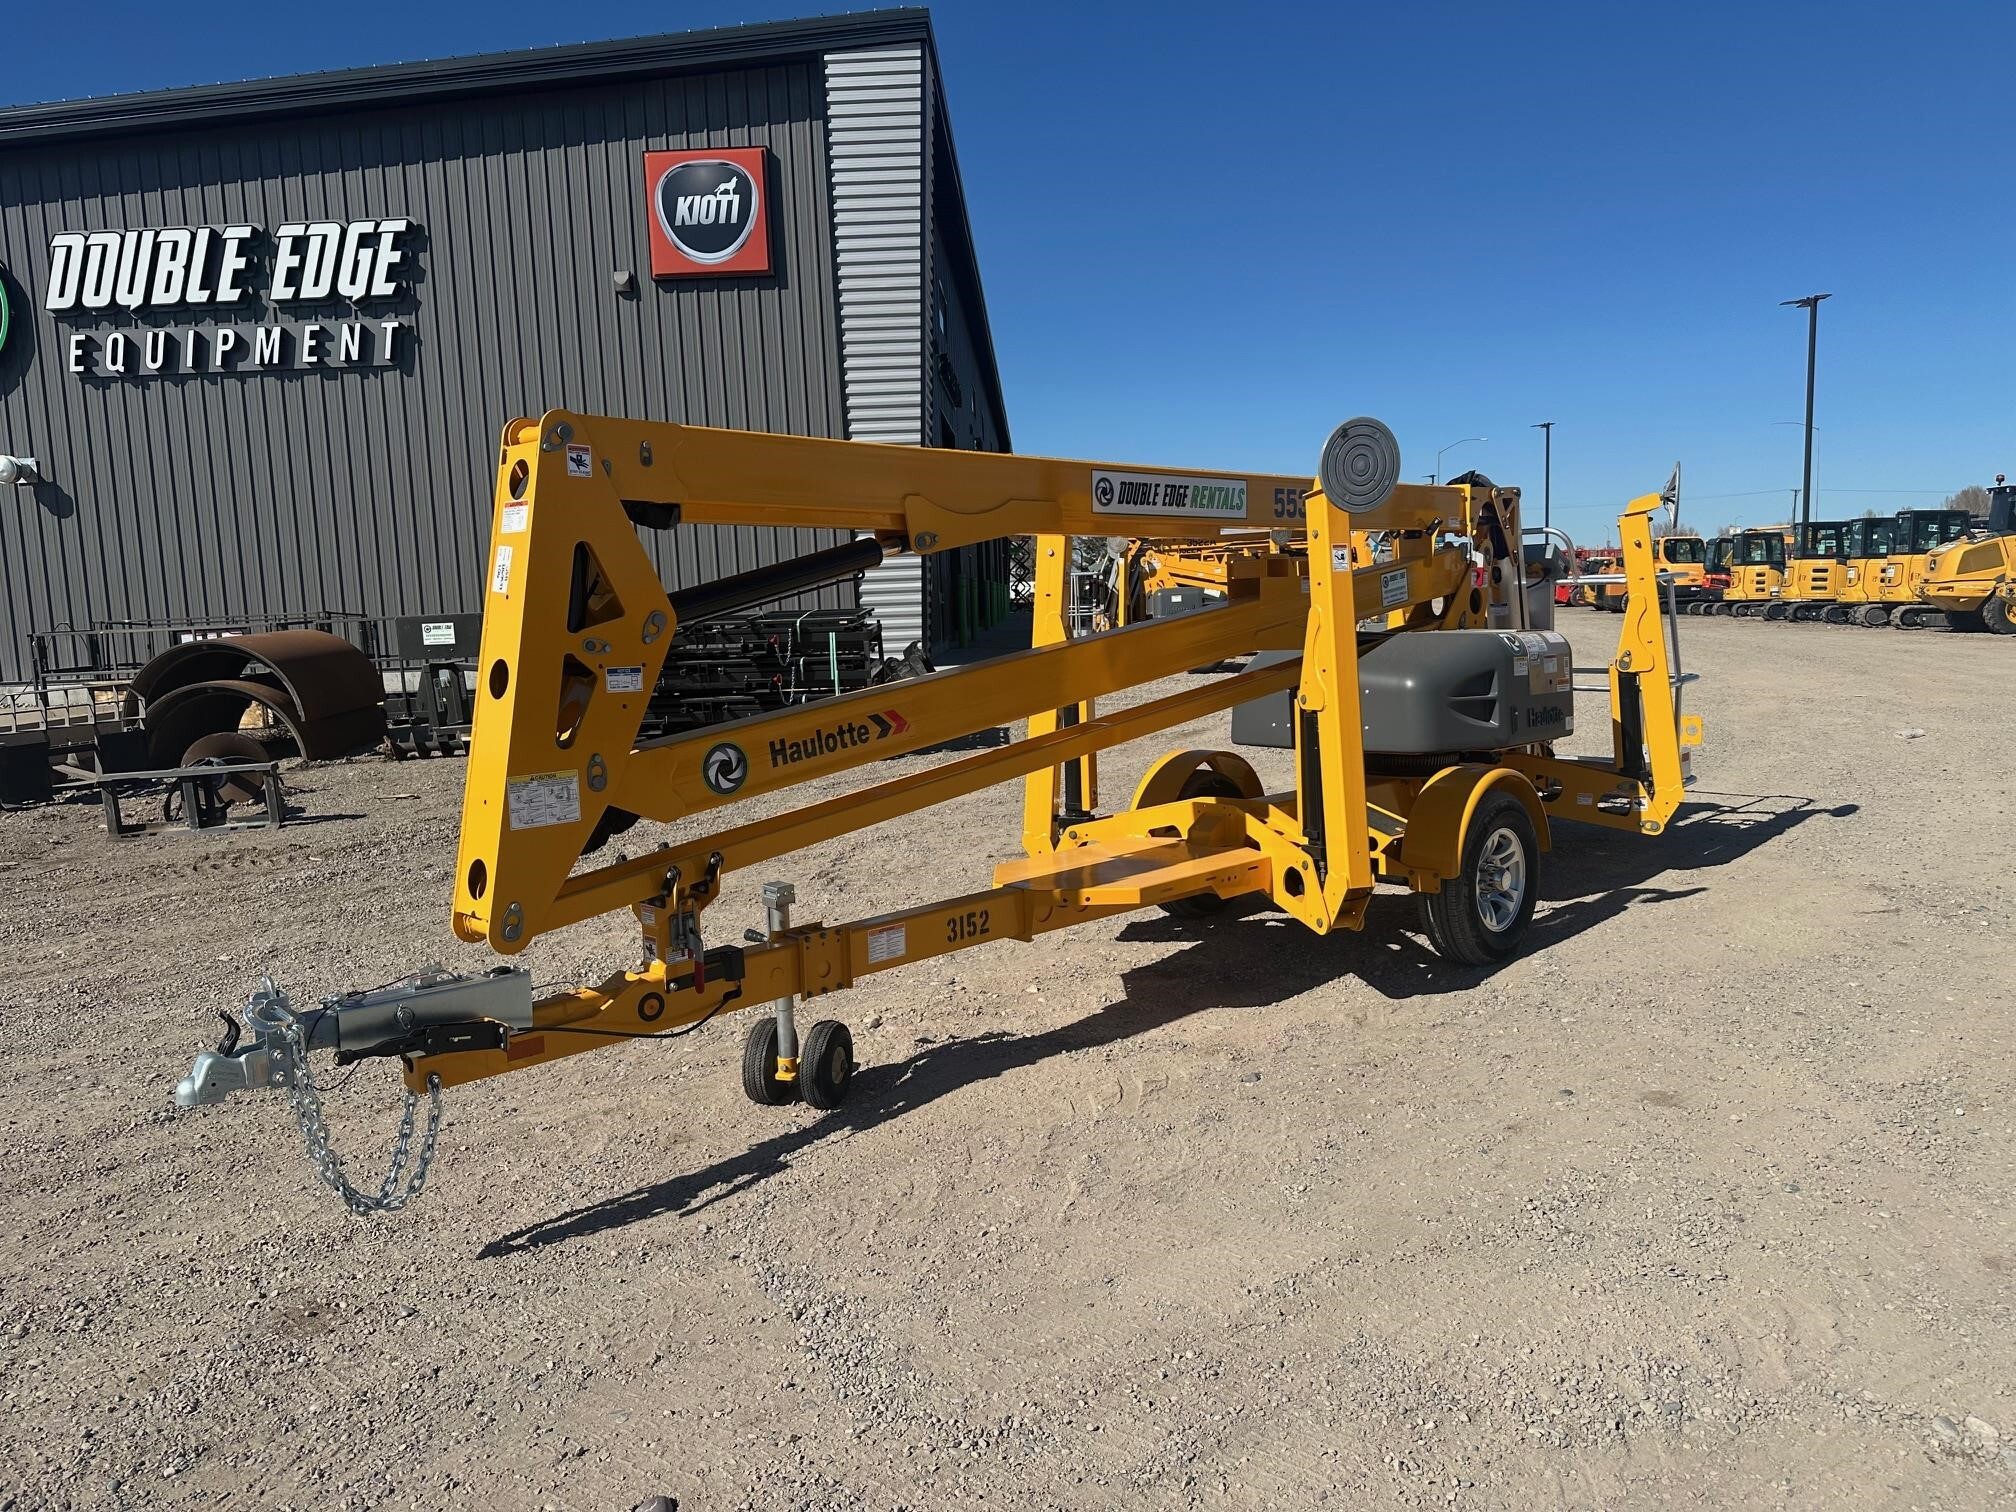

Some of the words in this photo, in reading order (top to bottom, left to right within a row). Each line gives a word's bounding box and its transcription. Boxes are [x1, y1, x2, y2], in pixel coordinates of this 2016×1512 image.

[674, 194, 740, 227] KIOTI
[45, 225, 252, 311] DOUBLE
[270, 219, 408, 302] EDGE
[69, 321, 399, 373] EQUIPMENT
[1117, 481, 1160, 507] DOUBLE
[1162, 484, 1190, 508] EDGE
[1190, 485, 1245, 511] RENTALS
[768, 722, 870, 768] Haulotte
[946, 909, 990, 943] 3152
